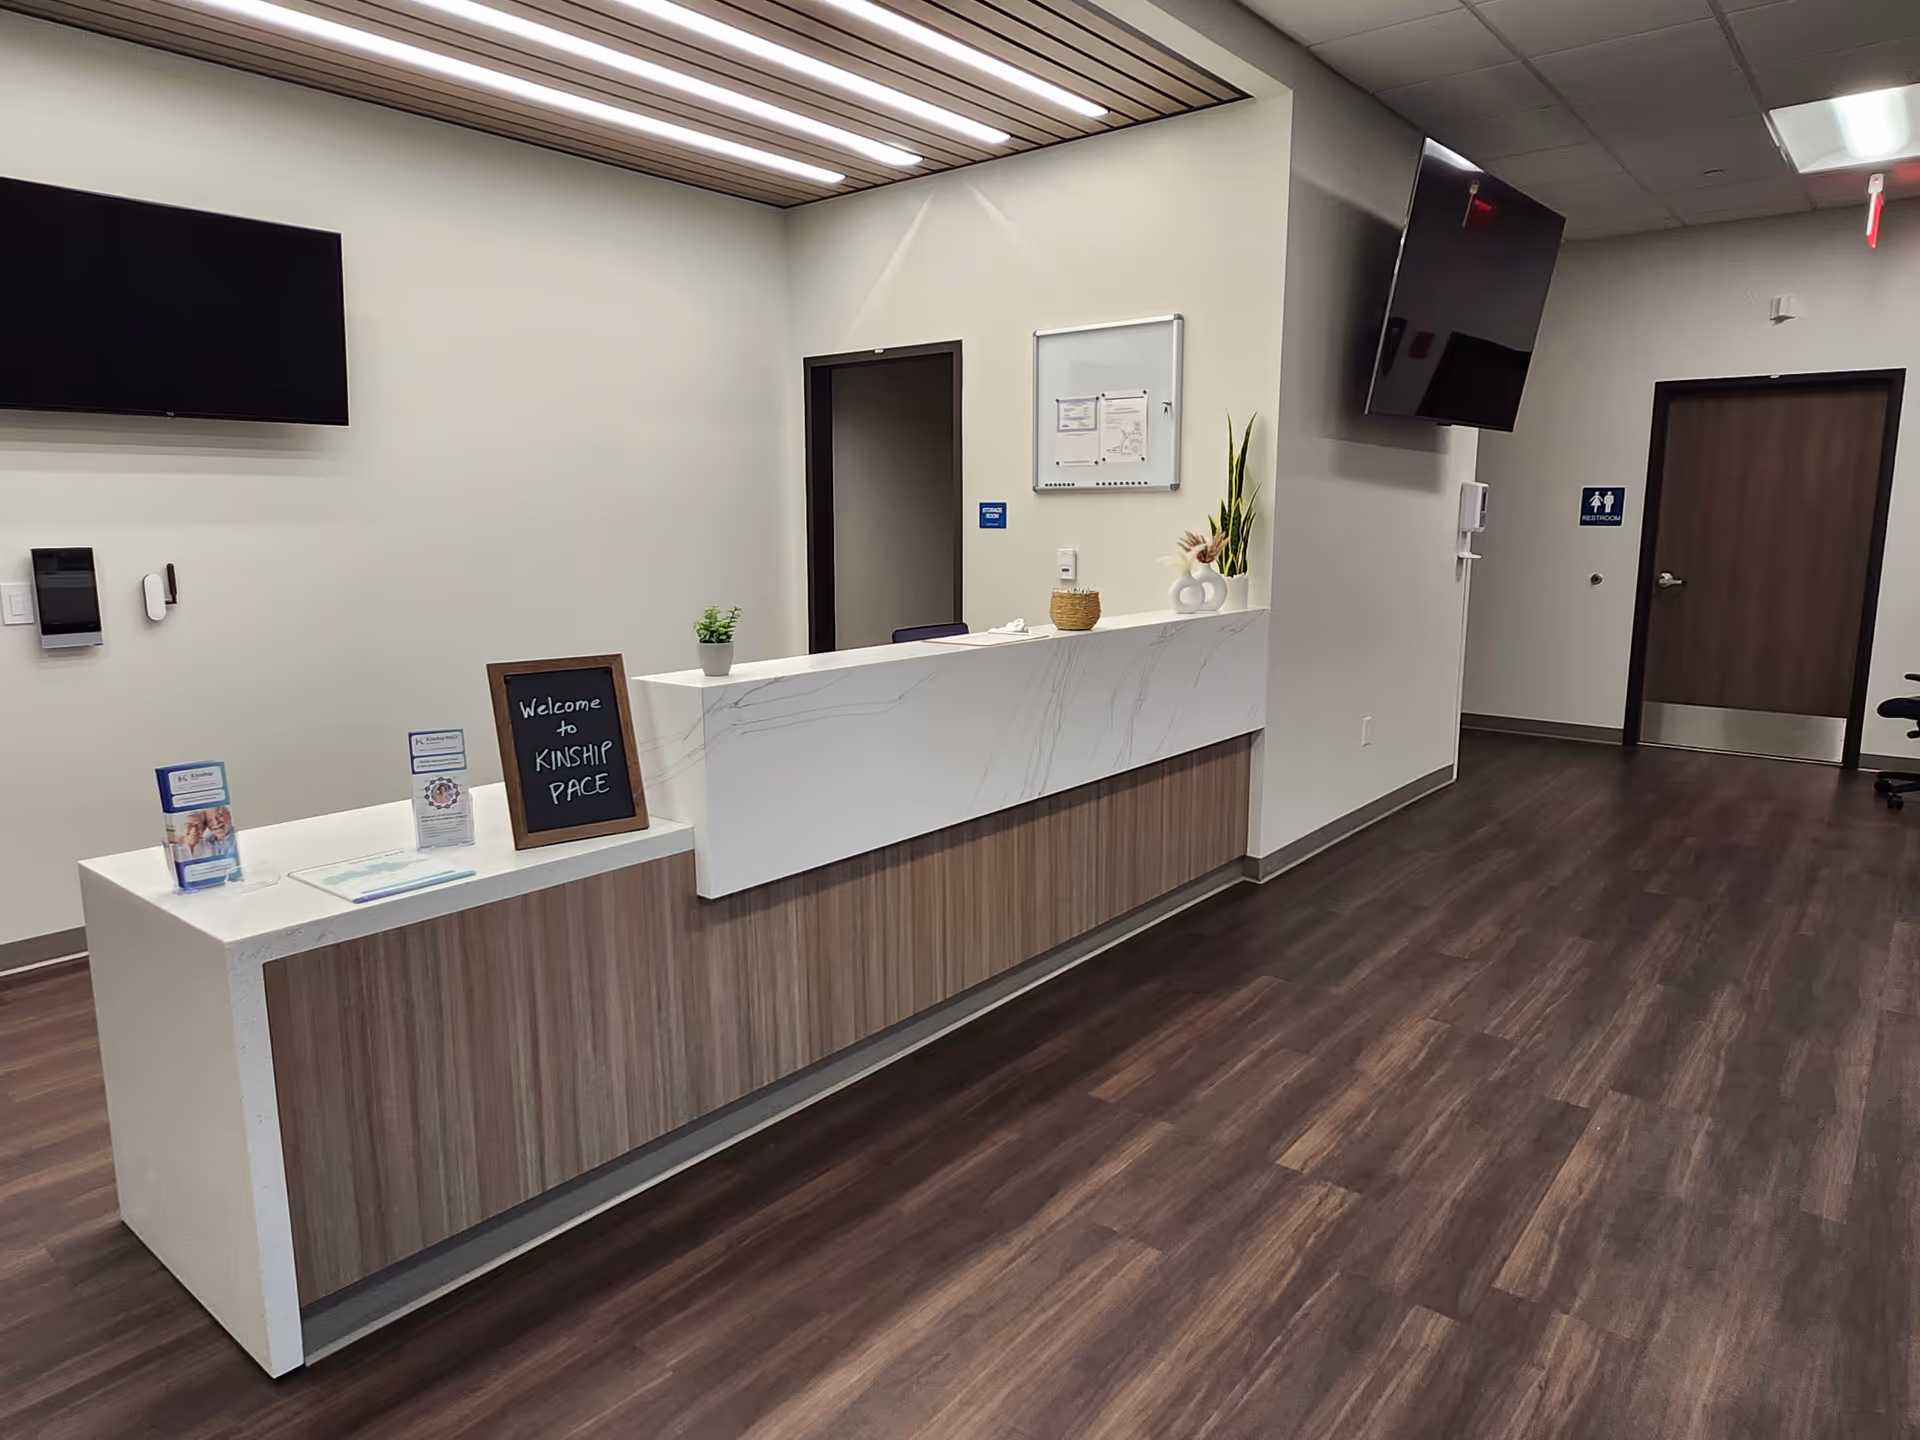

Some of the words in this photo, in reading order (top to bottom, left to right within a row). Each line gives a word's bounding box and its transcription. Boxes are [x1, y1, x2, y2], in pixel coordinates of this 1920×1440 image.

[519, 696, 601, 719] Welcome
[556, 720, 577, 737] to
[535, 740, 613, 772] KINSHIP
[548, 772, 610, 805] PACE
